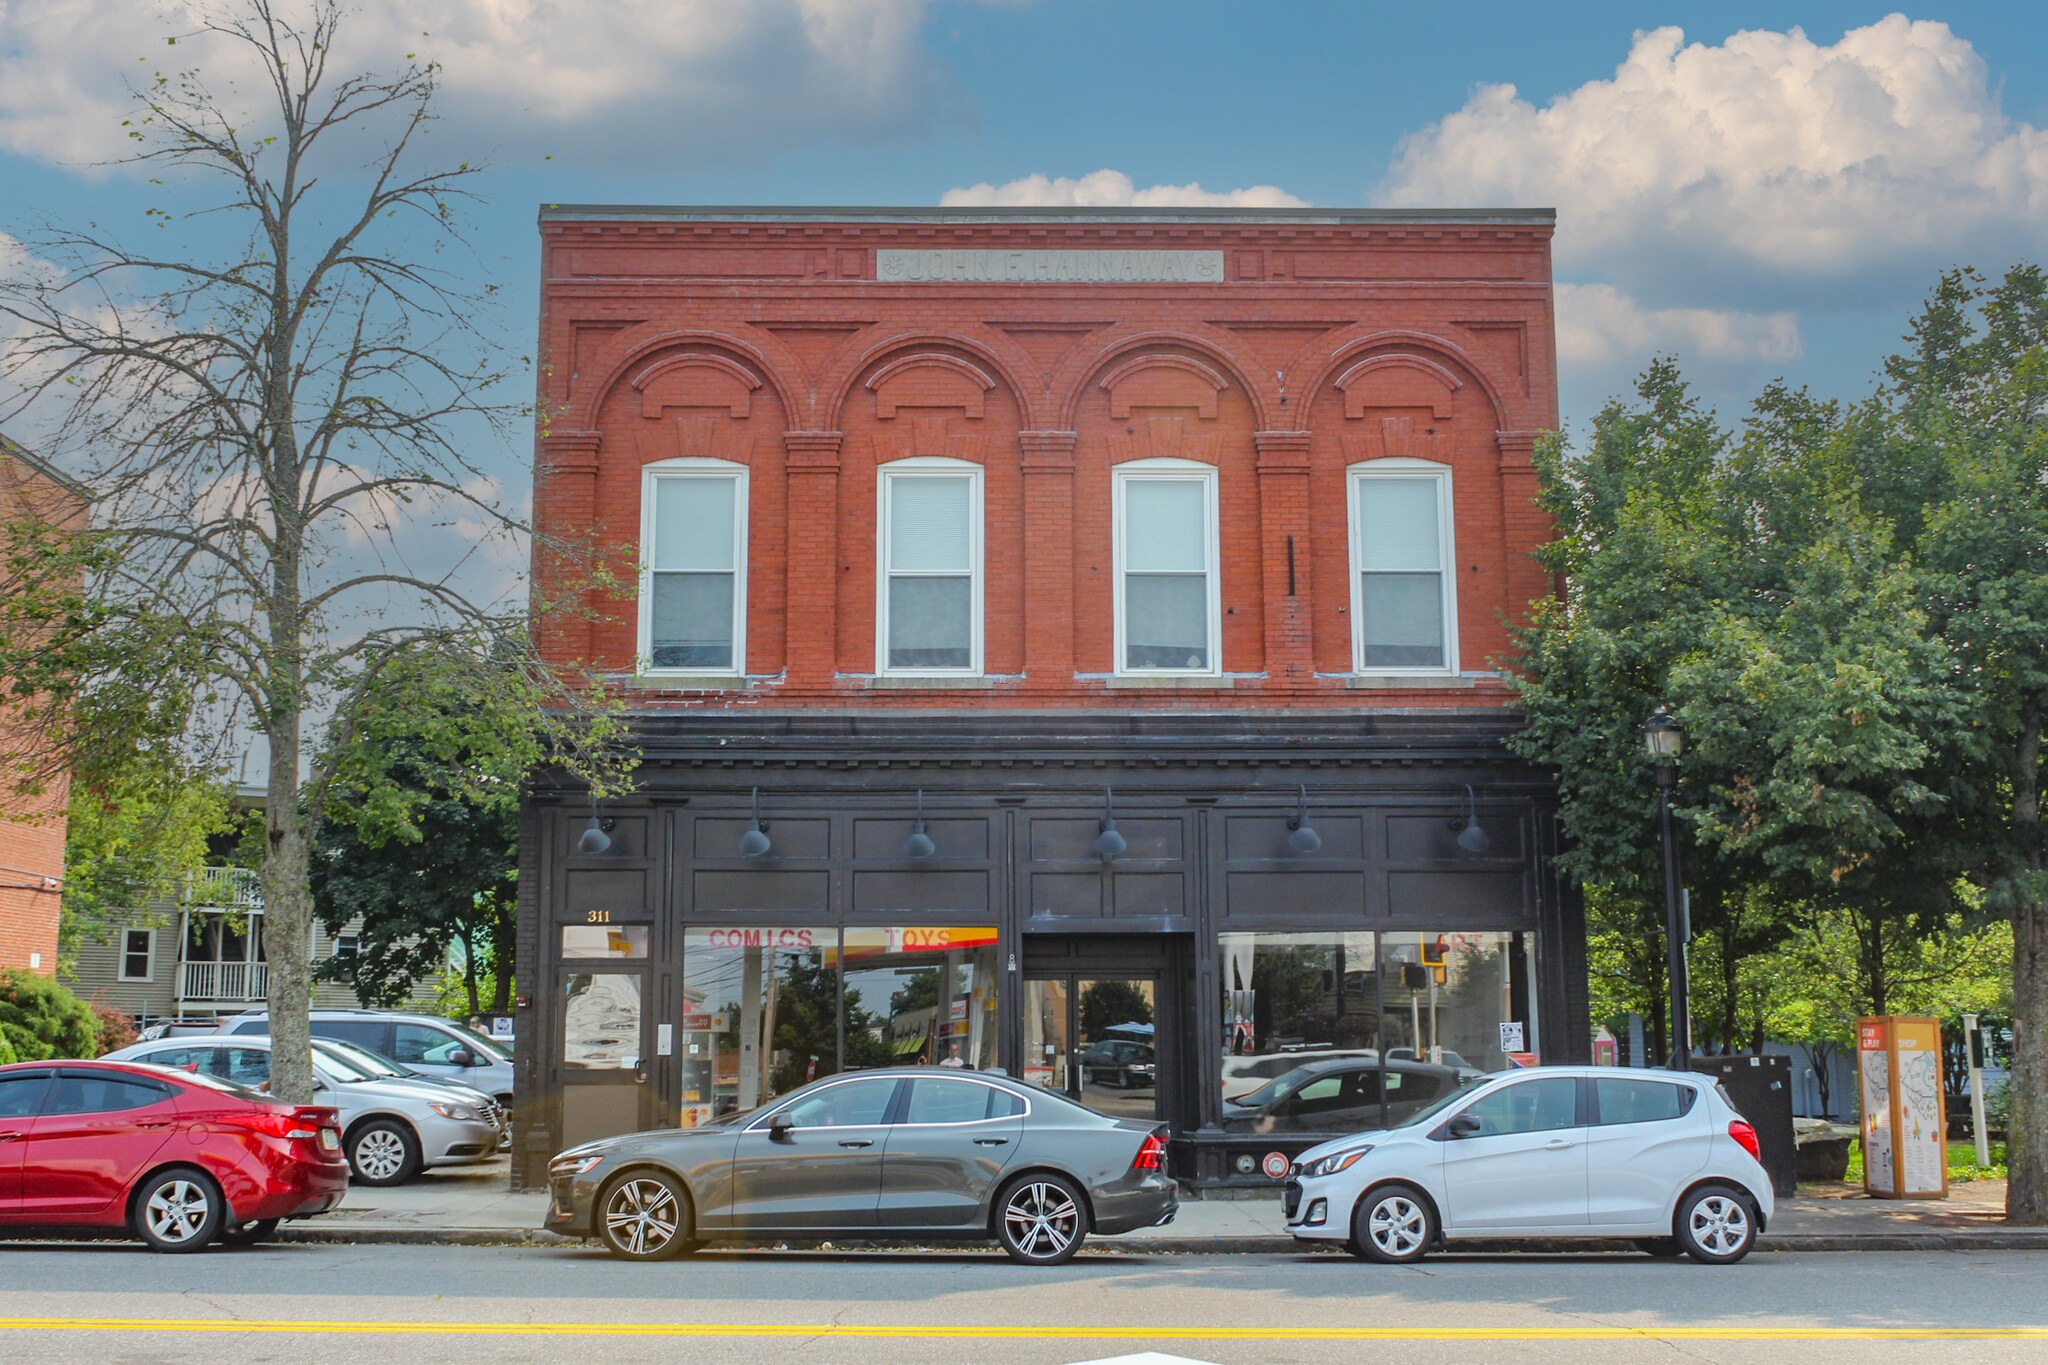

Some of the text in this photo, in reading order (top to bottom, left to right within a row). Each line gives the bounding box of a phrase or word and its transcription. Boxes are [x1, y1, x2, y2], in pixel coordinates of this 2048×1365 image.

[908, 251, 993, 281] JOHN
[1032, 251, 1194, 282] HANNAWAY
[587, 910, 611, 923] 311
[709, 928, 813, 948] COMICS
[884, 928, 951, 947] TOYS
[1434, 933, 1483, 954] ART
[1898, 1039, 1917, 1048] SHOP
